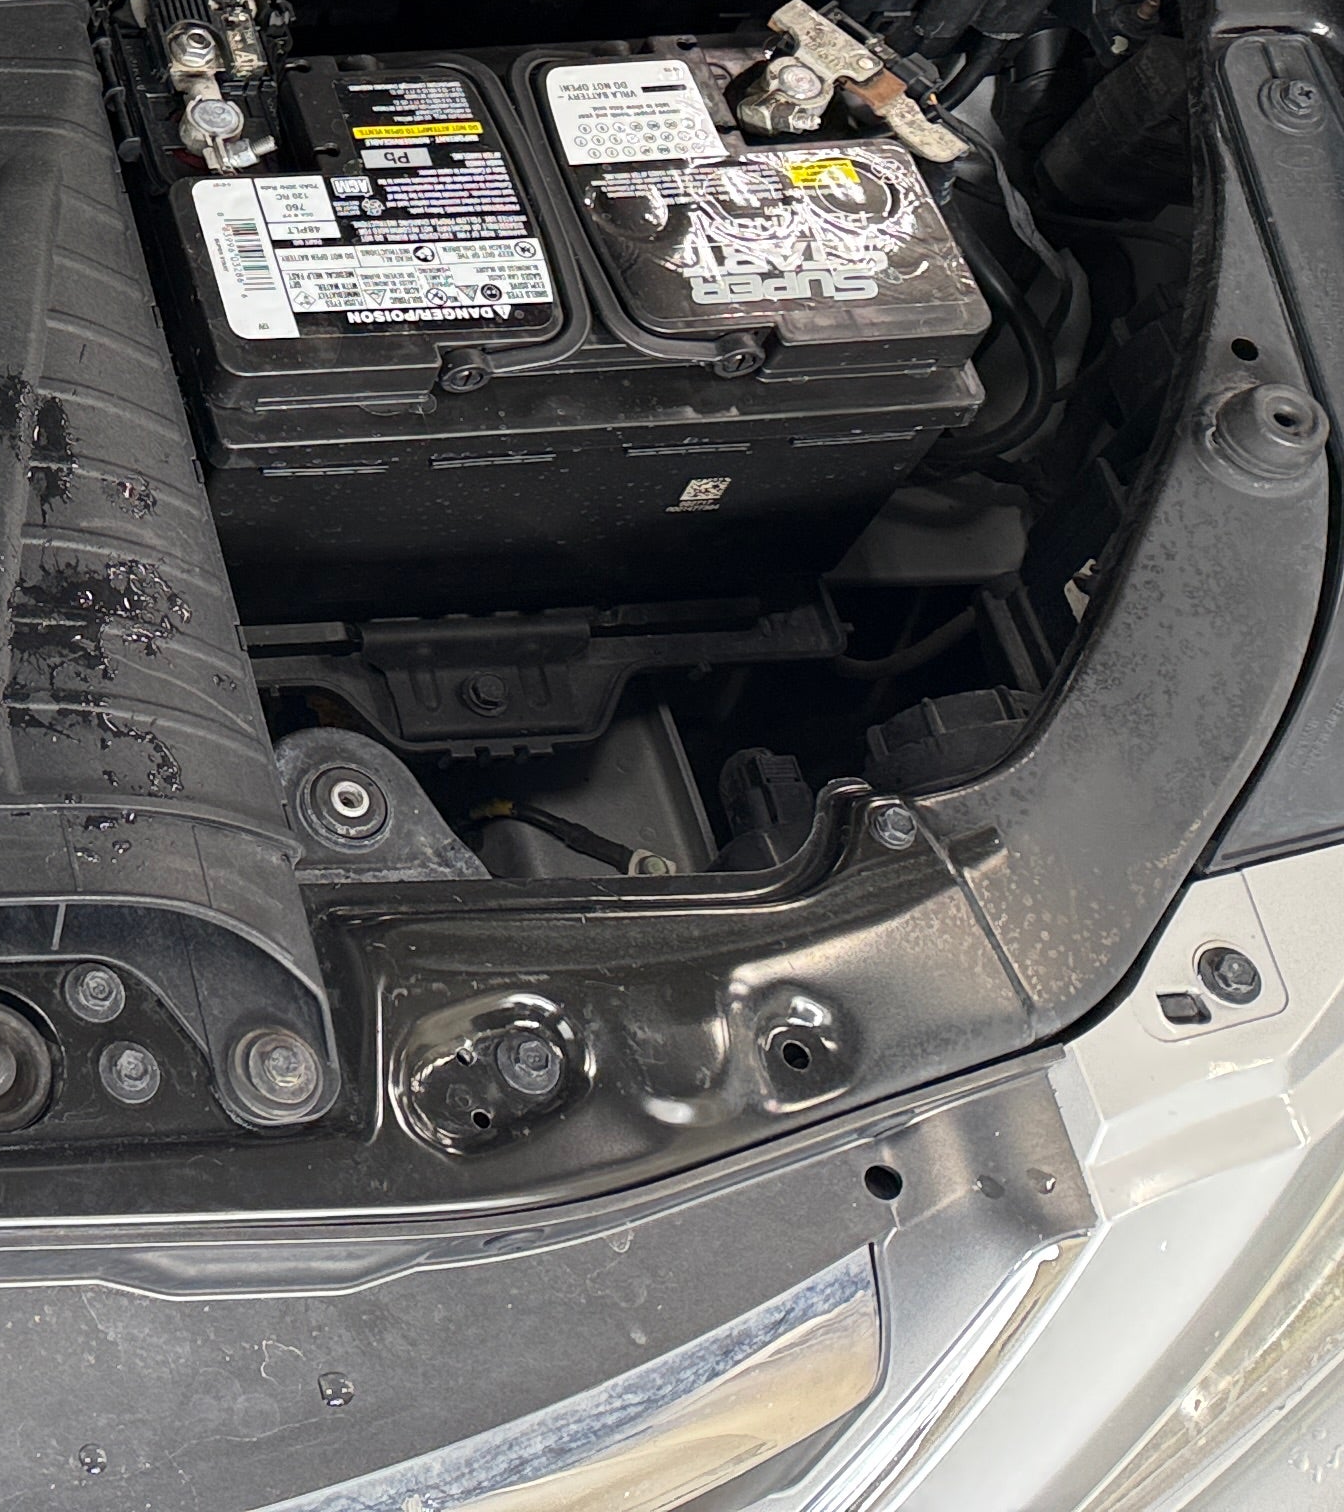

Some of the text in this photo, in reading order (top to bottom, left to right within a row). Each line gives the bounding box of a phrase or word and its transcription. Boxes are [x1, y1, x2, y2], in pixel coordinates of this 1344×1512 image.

[568, 92, 608, 100] BATTERY
[383, 152, 410, 164] Pb
[285, 203, 305, 211] 760
[287, 226, 321, 234] 48PLT
[689, 270, 879, 304] SUPER
[347, 305, 493, 323] DANGER/POISON
